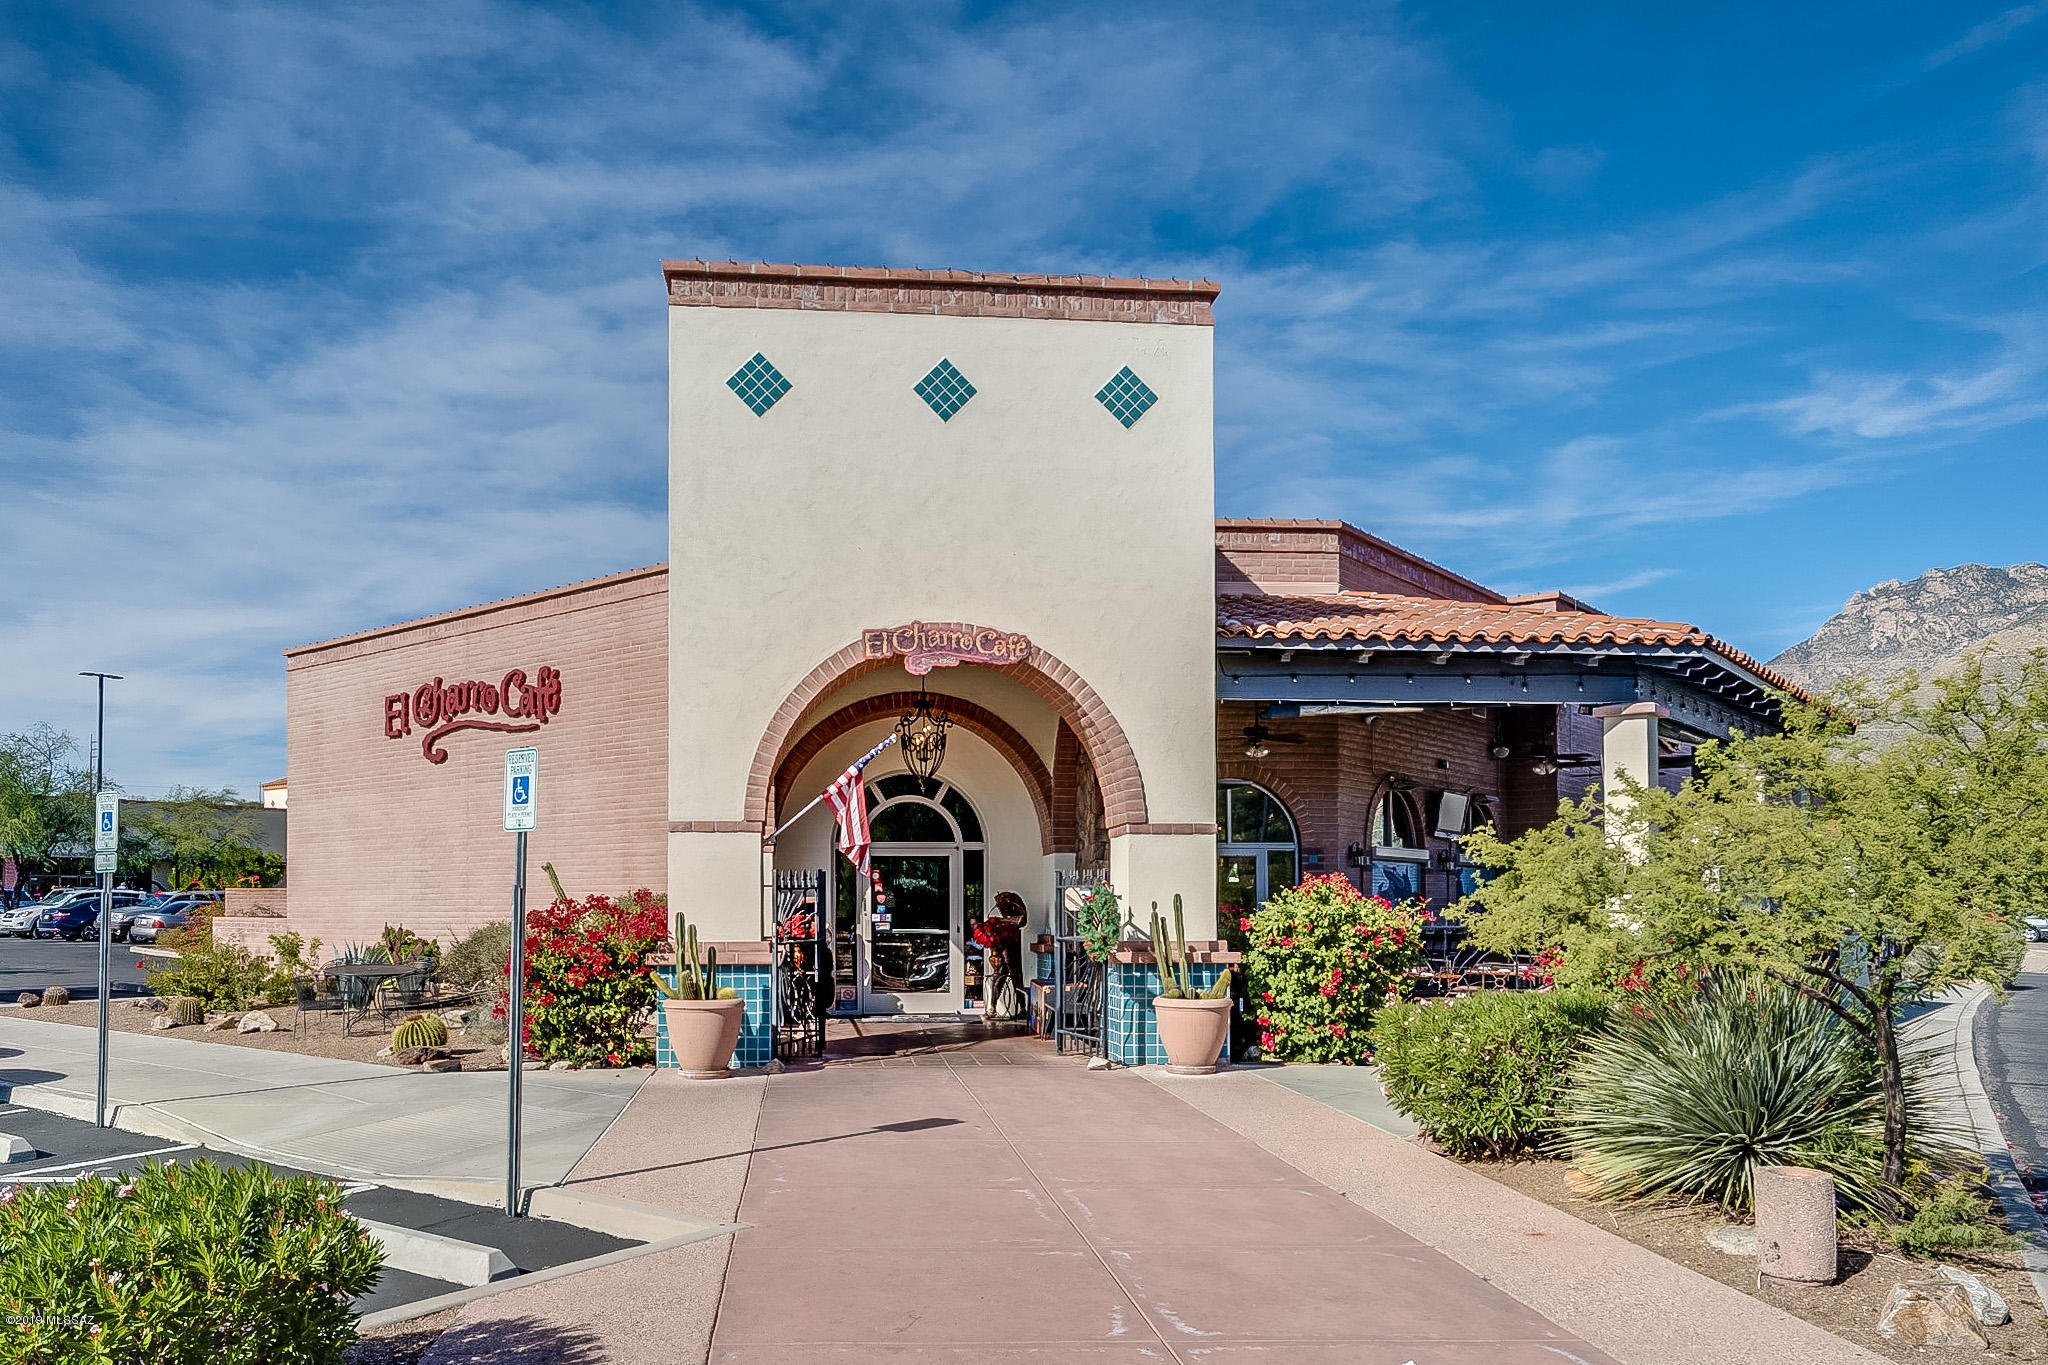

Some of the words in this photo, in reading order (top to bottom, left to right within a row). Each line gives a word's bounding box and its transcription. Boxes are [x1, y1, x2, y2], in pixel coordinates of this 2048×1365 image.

[865, 631, 891, 657] El
[892, 622, 973, 652] Charro
[384, 692, 411, 739] El
[412, 676, 499, 728] Charro
[500, 666, 561, 724] Café
[508, 752, 536, 765] RESERVED
[510, 764, 533, 775] PARKING
